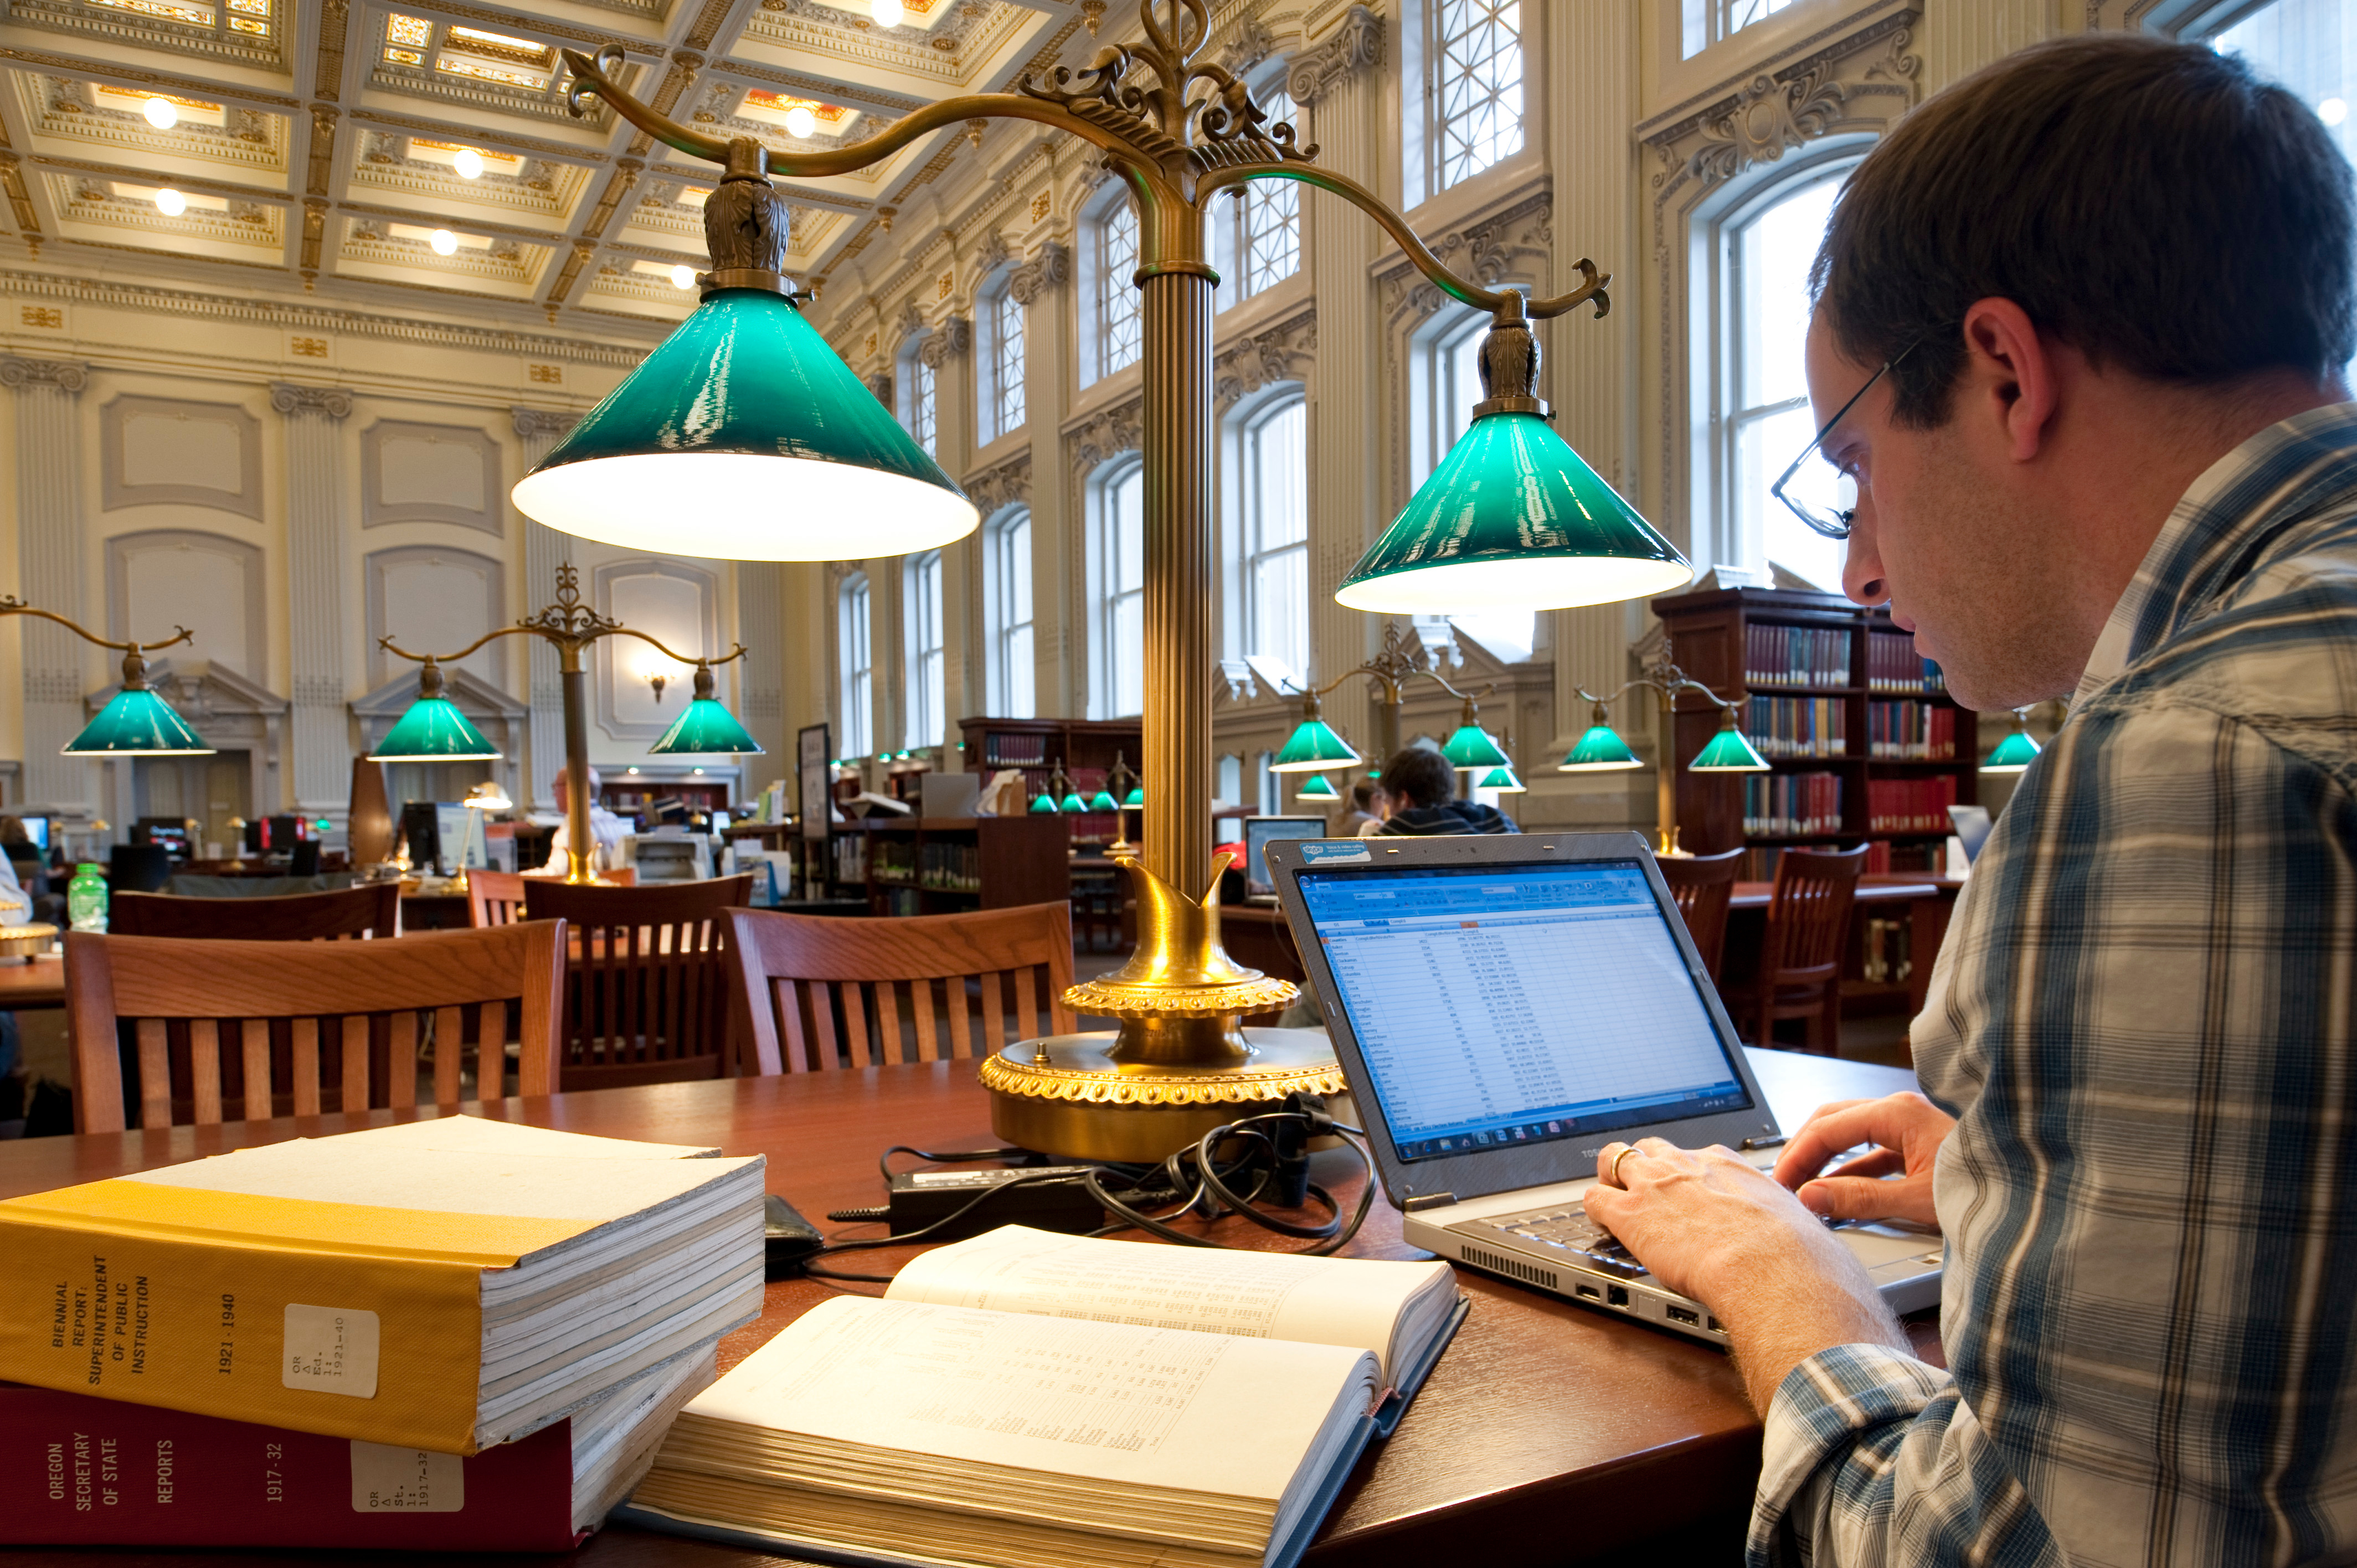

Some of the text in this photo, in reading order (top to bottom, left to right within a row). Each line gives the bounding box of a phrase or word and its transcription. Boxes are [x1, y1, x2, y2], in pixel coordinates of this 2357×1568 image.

[1303, 845, 1323, 855] skype
[53, 1281, 67, 1348] BIENNIAL
[72, 1286, 87, 1347] REPORT:
[89, 1255, 107, 1385] SUPERINTENDENT
[112, 1282, 128, 1361] OF PUBLIC
[131, 1276, 148, 1374] INSTRUCTION
[222, 1293, 234, 1328] 1940
[218, 1342, 233, 1375] 1921
[292, 1356, 301, 1373] OR
[313, 1352, 322, 1376] Ed.
[333, 1317, 344, 1377] 1921-40
[48, 1443, 64, 1499] OREGON
[74, 1432, 92, 1511] SECRETARY
[101, 1438, 118, 1505] OF STATE
[157, 1440, 173, 1503] REPORTS
[370, 1491, 379, 1507] OR
[394, 1486, 404, 1507] St.
[418, 1452, 429, 1507] 1917-32
